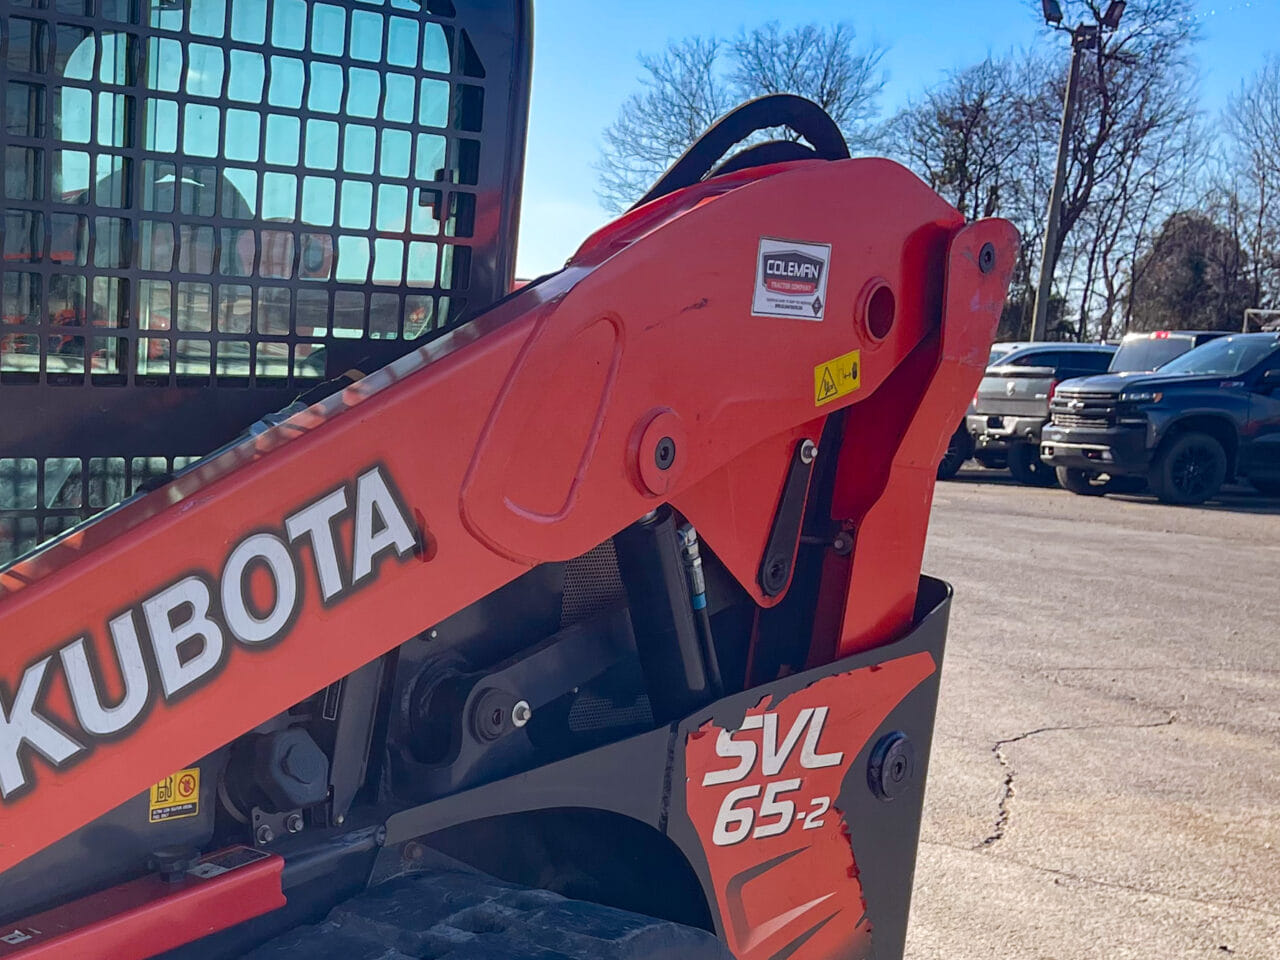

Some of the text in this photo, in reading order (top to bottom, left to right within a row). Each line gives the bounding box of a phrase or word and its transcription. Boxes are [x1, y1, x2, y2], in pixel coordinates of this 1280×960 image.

[766, 260, 819, 278] COLEMAN
[702, 706, 843, 787] SVL
[712, 778, 830, 846] 65-2
